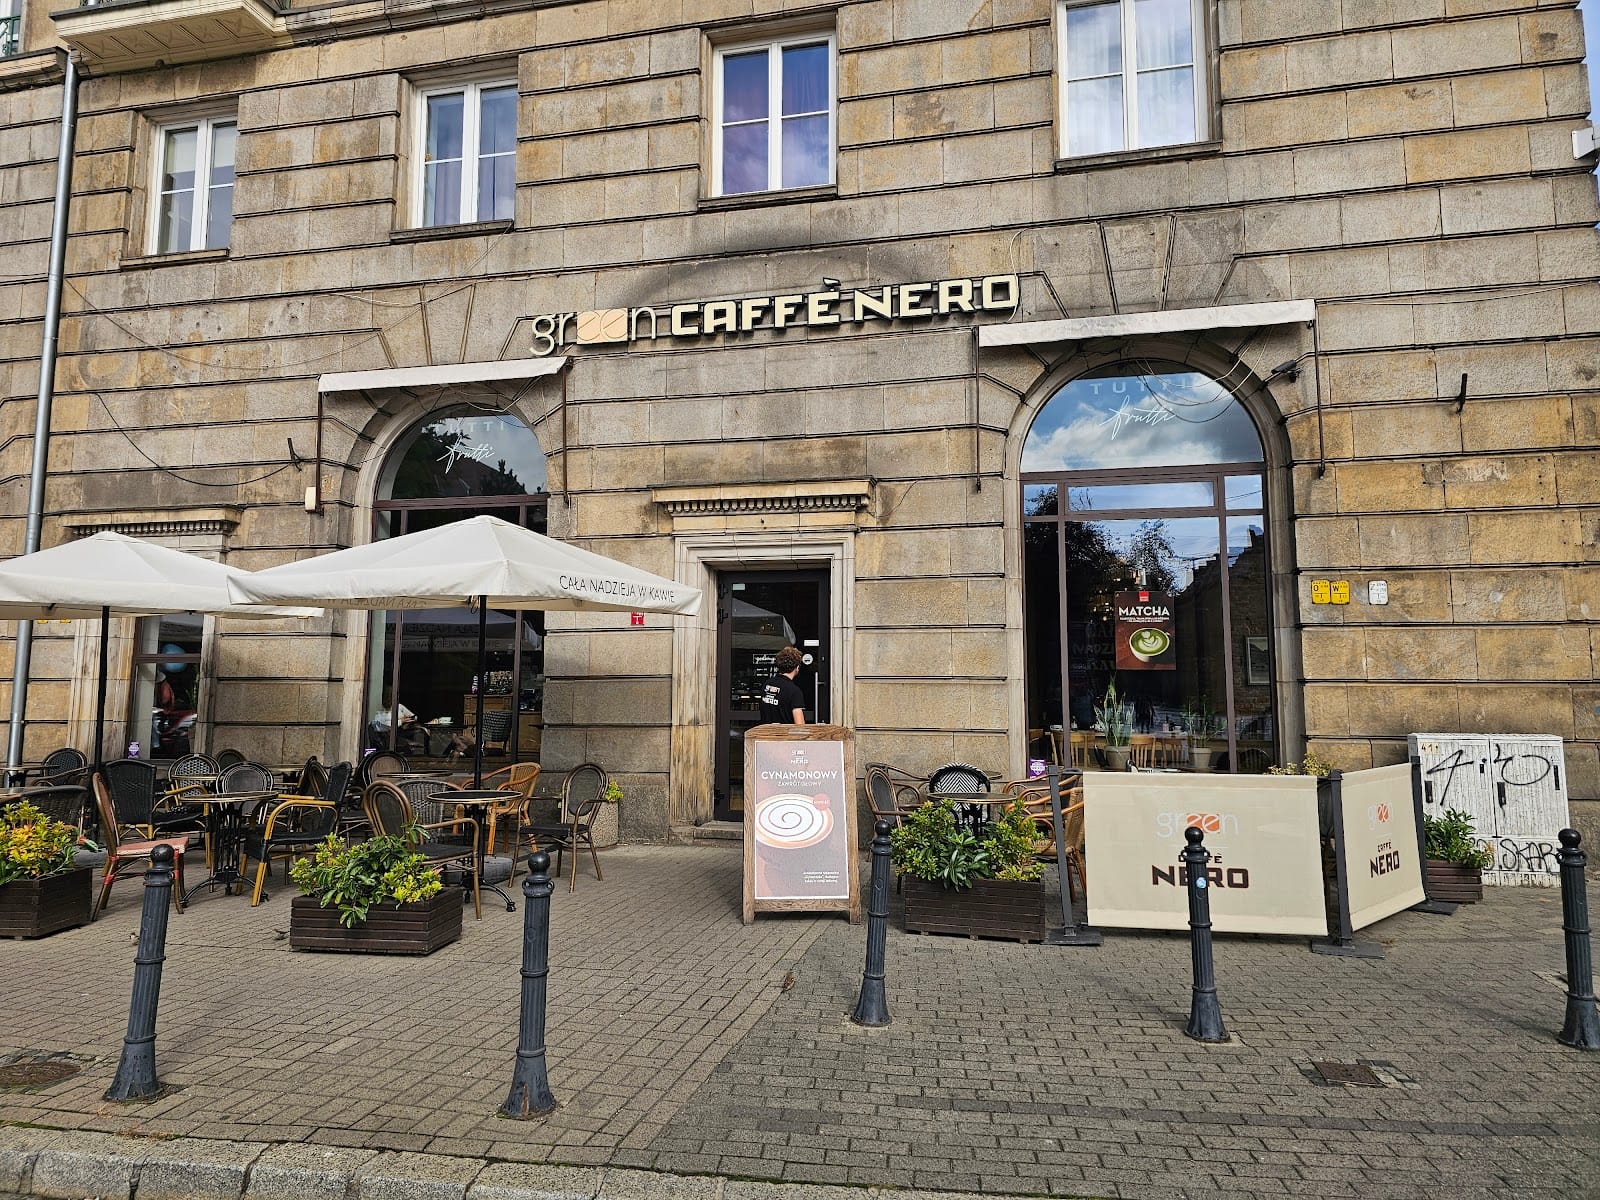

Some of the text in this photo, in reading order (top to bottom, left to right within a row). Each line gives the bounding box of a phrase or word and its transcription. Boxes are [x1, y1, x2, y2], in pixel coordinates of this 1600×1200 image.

[530, 274, 1020, 356] green CAFFÈ NERO
[559, 575, 675, 603] CAŁA NADZIEJA W KAWIE
[1118, 606, 1170, 616] MATCHA
[761, 770, 838, 780] CYNAMONOWY
[1157, 812, 1240, 838] green
[1369, 850, 1400, 878] NERO
